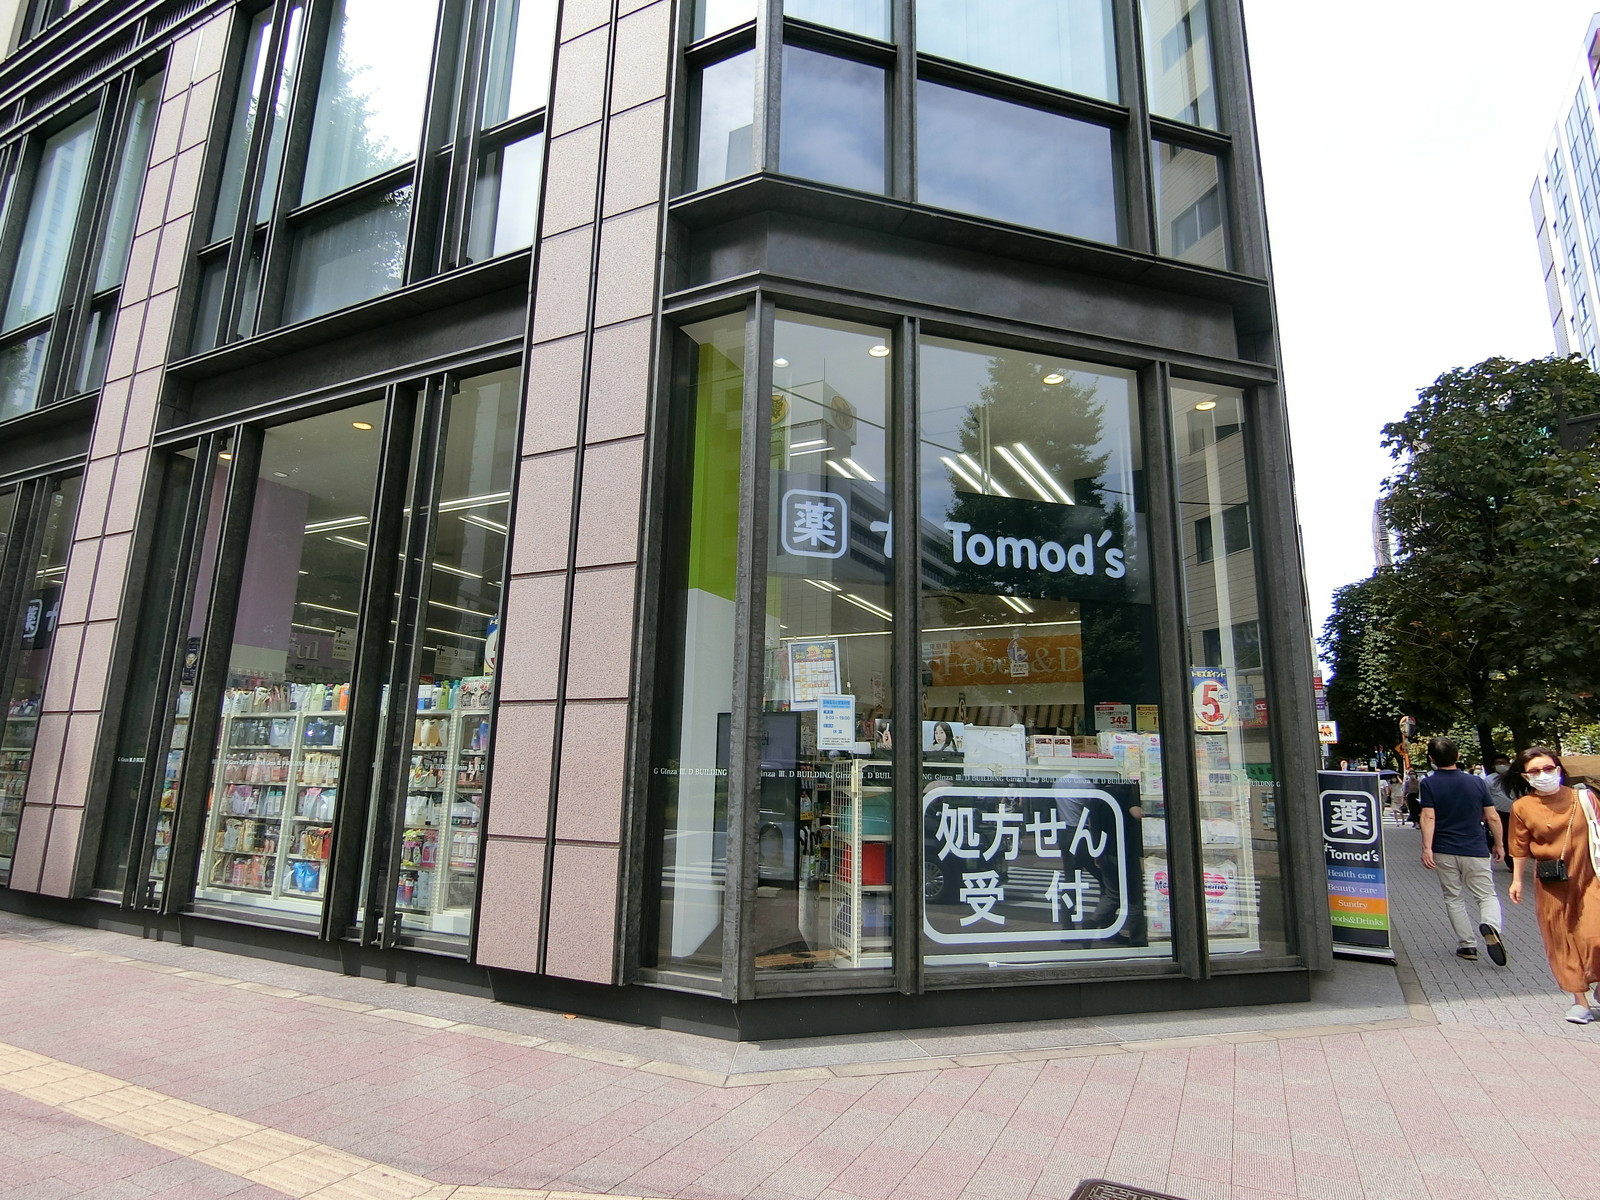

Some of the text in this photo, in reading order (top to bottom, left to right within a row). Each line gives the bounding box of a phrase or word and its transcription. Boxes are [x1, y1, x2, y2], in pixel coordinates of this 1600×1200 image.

[792, 501, 836, 547] 薬
[943, 521, 1126, 579] Tomod's
[1110, 716, 1128, 725] 348
[796, 771, 833, 779] BUILDING
[1330, 799, 1370, 835] 薬
[935, 802, 1108, 862] 処方せん
[1329, 849, 1380, 862] Tomod's
[1328, 869, 1356, 879] Health
[1328, 883, 1378, 894] Beauty care
[1338, 899, 1368, 910] Sundry
[1330, 915, 1384, 926] oods&Drinks
